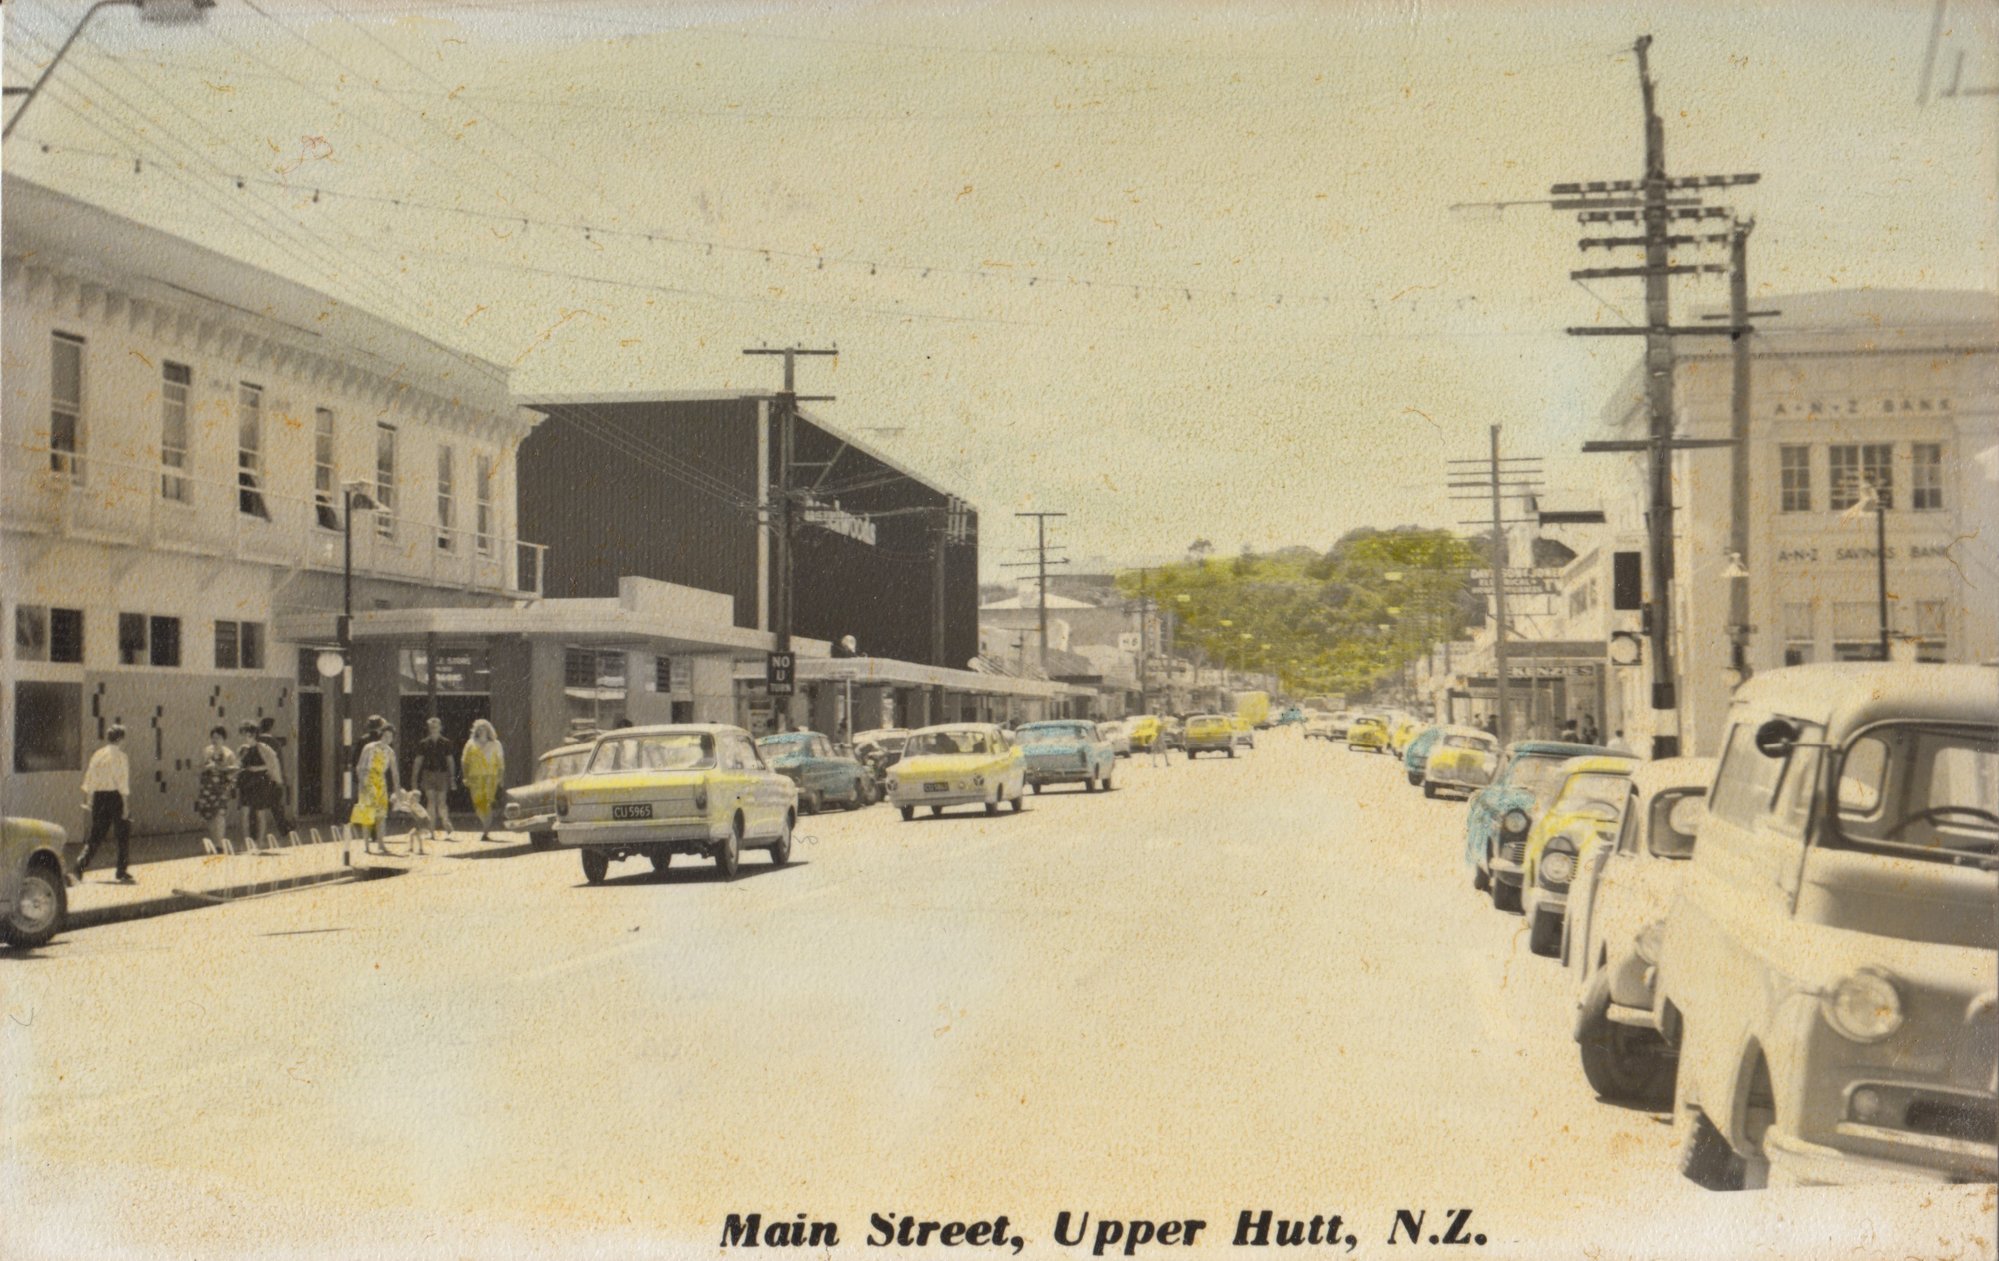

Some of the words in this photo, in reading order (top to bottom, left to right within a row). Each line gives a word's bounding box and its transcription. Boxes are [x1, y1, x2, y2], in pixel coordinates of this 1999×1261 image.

[1882, 398, 1951, 413] BANK
[1835, 547, 1896, 560] SAVINS
[771, 655, 791, 668] NO
[776, 670, 786, 681] U
